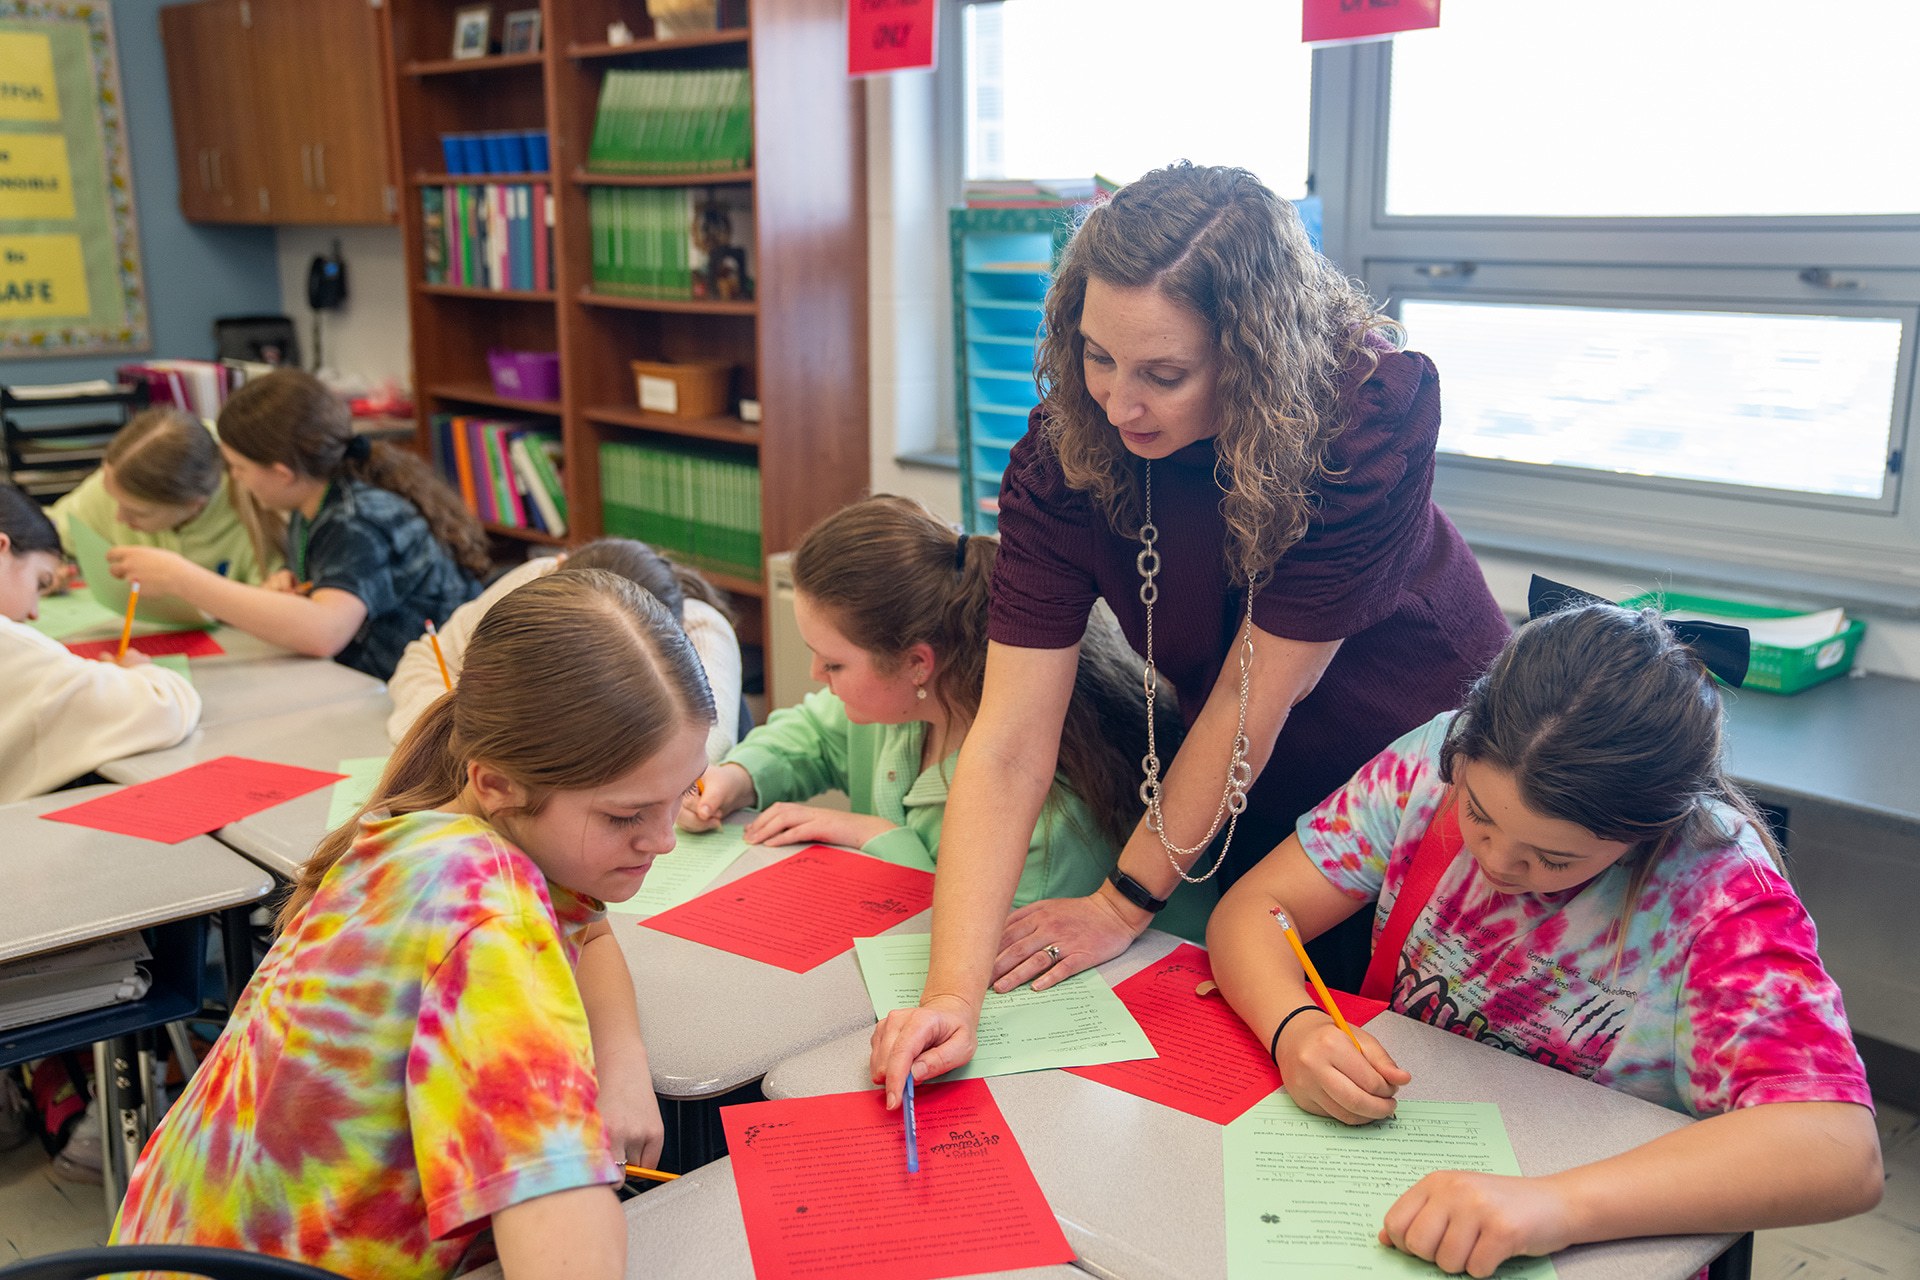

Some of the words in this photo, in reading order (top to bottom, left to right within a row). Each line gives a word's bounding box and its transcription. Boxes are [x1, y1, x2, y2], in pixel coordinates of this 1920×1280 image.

[948, 1128, 975, 1141] Day
[929, 1137, 983, 1155] Patrick's
[951, 1147, 987, 1159] Happy
